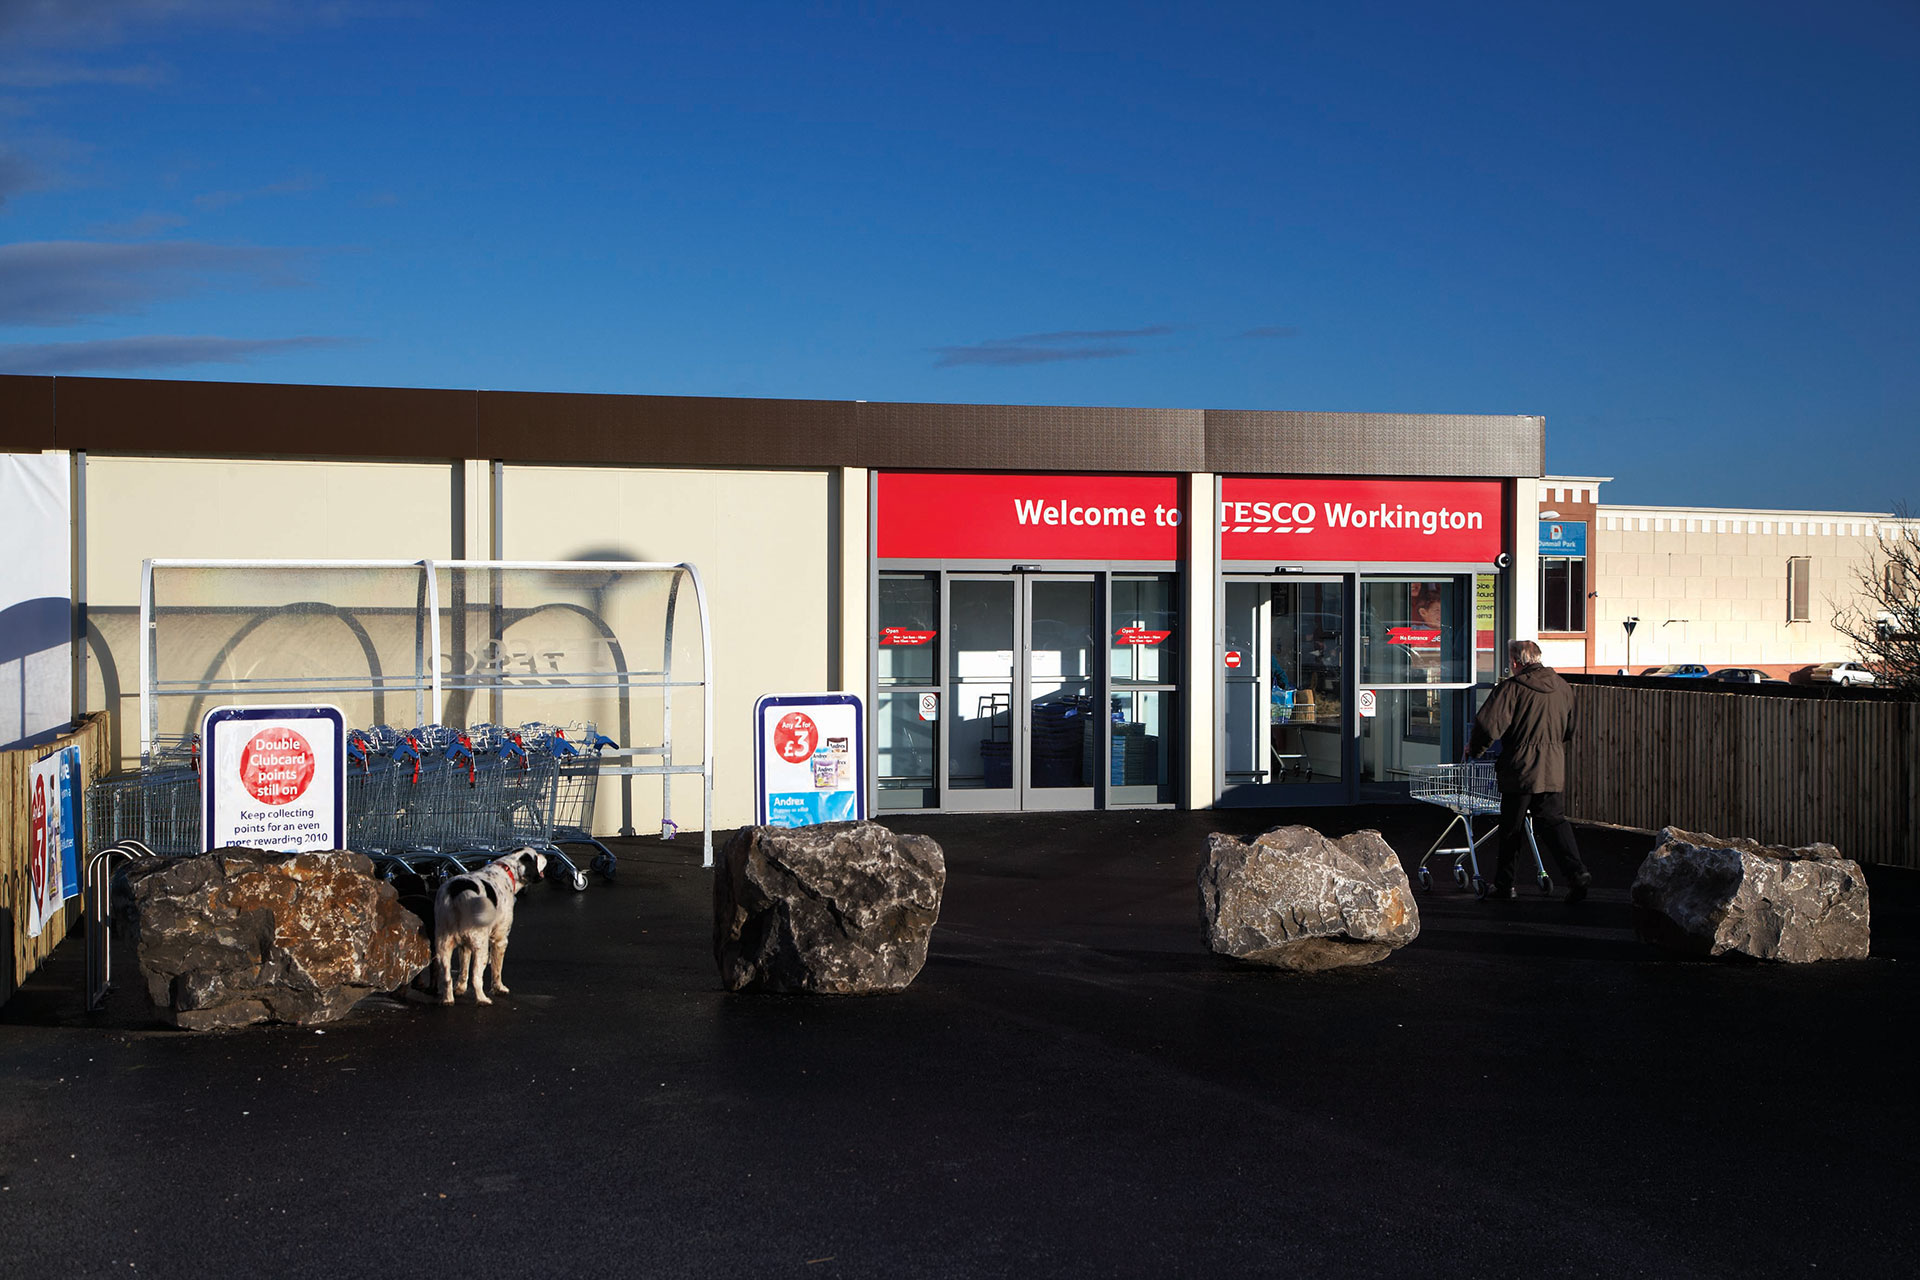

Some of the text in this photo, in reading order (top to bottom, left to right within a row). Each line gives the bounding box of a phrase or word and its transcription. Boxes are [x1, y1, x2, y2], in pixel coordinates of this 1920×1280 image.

[1014, 499, 1182, 528] Welcome to
[1221, 501, 1483, 535] TESCO Workington
[1562, 540, 1576, 548] Park
[781, 722, 794, 730] Any
[794, 716, 802, 728] 2
[255, 738, 300, 751] Double
[784, 730, 810, 757] £3
[250, 752, 305, 766] Clubcard
[258, 768, 297, 783] points
[257, 784, 298, 797] still on
[774, 797, 804, 807] Andrex
[240, 808, 314, 821] Keep collecting
[234, 822, 320, 835] points for an even
[226, 833, 328, 848] more rewarding 2010
